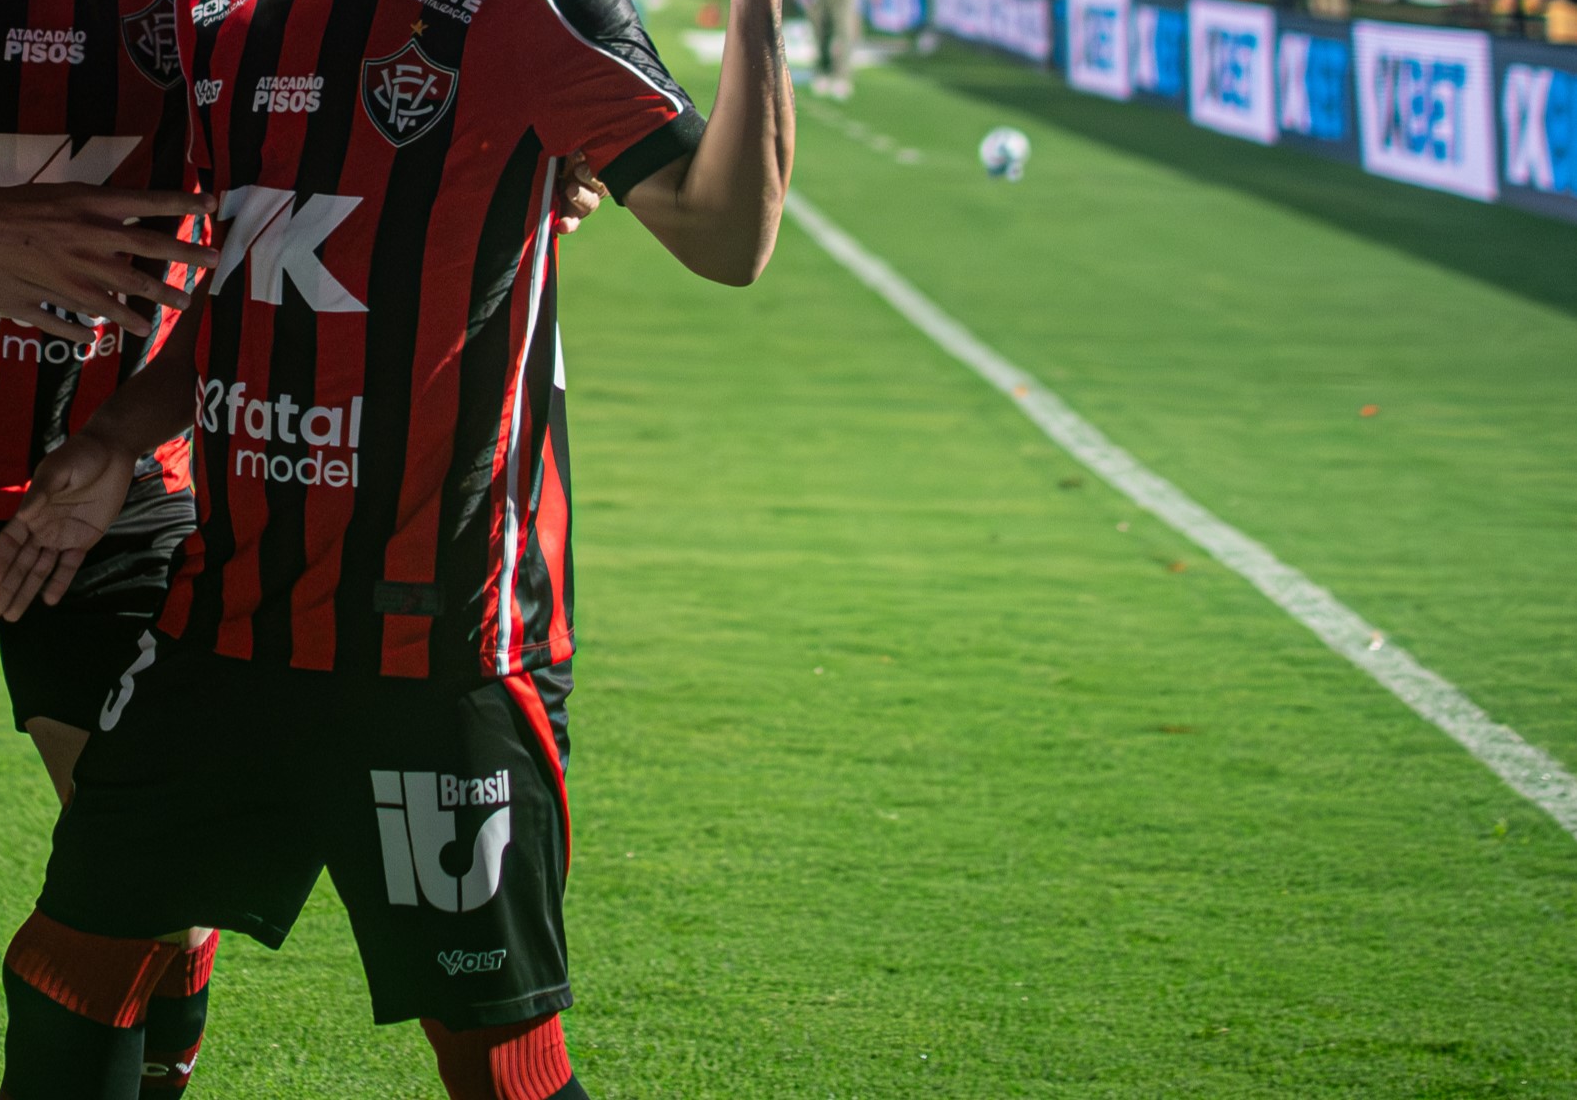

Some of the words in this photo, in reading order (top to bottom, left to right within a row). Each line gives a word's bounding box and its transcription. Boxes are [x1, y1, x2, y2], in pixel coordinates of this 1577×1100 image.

[6, 27, 87, 44] ATACADÃO
[4, 41, 86, 64] PISOS
[256, 73, 324, 91] ATACADÃO
[252, 88, 321, 113] PISOS
[209, 184, 369, 312] 7K
[2, 325, 124, 364] model
[226, 381, 363, 448] fatal
[235, 449, 359, 488] model
[440, 769, 511, 807] Brasil
[437, 949, 507, 976] VOLT
